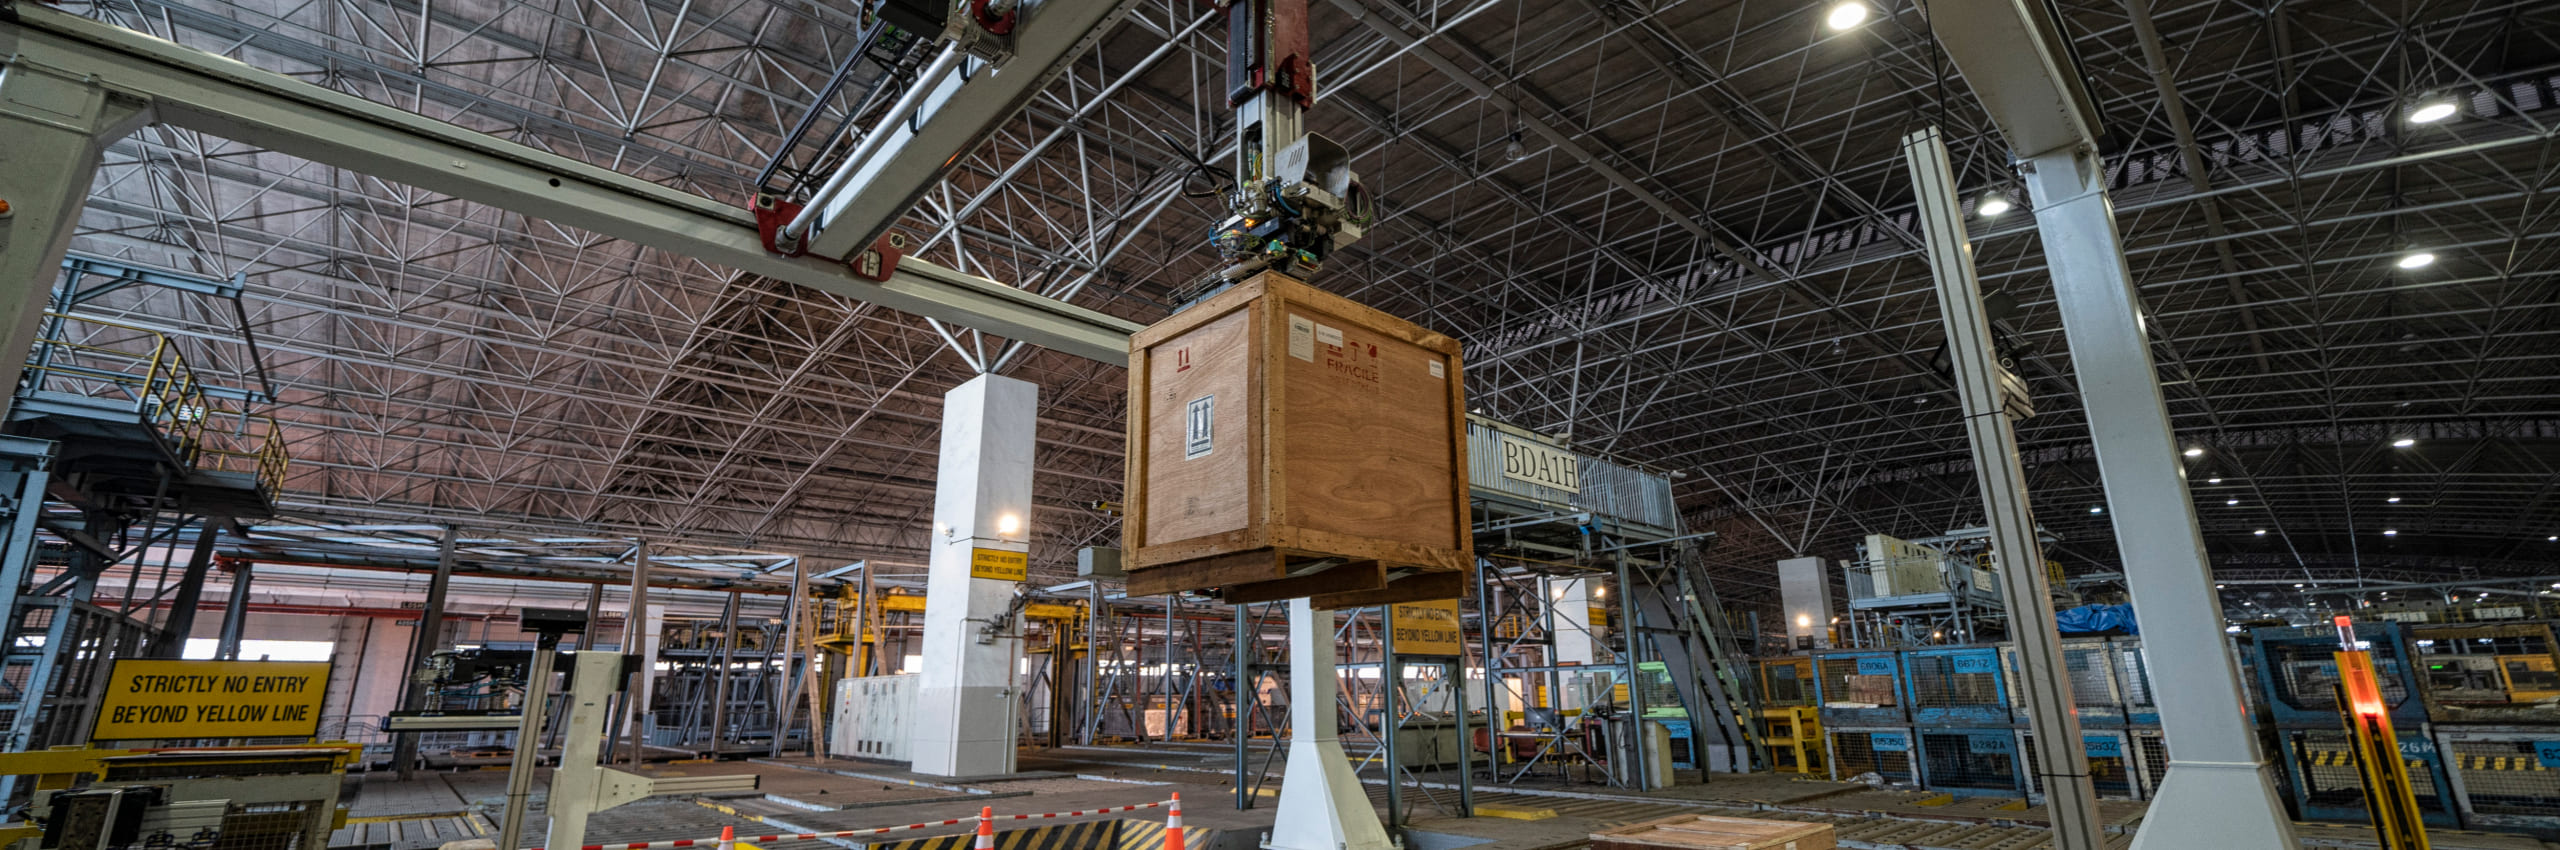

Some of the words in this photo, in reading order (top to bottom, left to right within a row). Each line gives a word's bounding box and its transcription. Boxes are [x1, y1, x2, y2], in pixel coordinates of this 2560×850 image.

[1504, 441, 1578, 489] BDA1H
[1399, 606, 1425, 619] STRICTLY
[1426, 608, 1434, 620] NO
[1435, 608, 1453, 620] ENTRY
[1396, 628, 1420, 641] BEYOND
[1421, 629, 1444, 642] YELLOW
[1445, 631, 1457, 643] LINE
[130, 675, 219, 693] STRICTLY
[223, 675, 248, 693] NO
[253, 676, 310, 693] ENTRY
[111, 705, 188, 724] BEYOND
[196, 705, 269, 722] YELLOW
[272, 704, 309, 721] LINE
